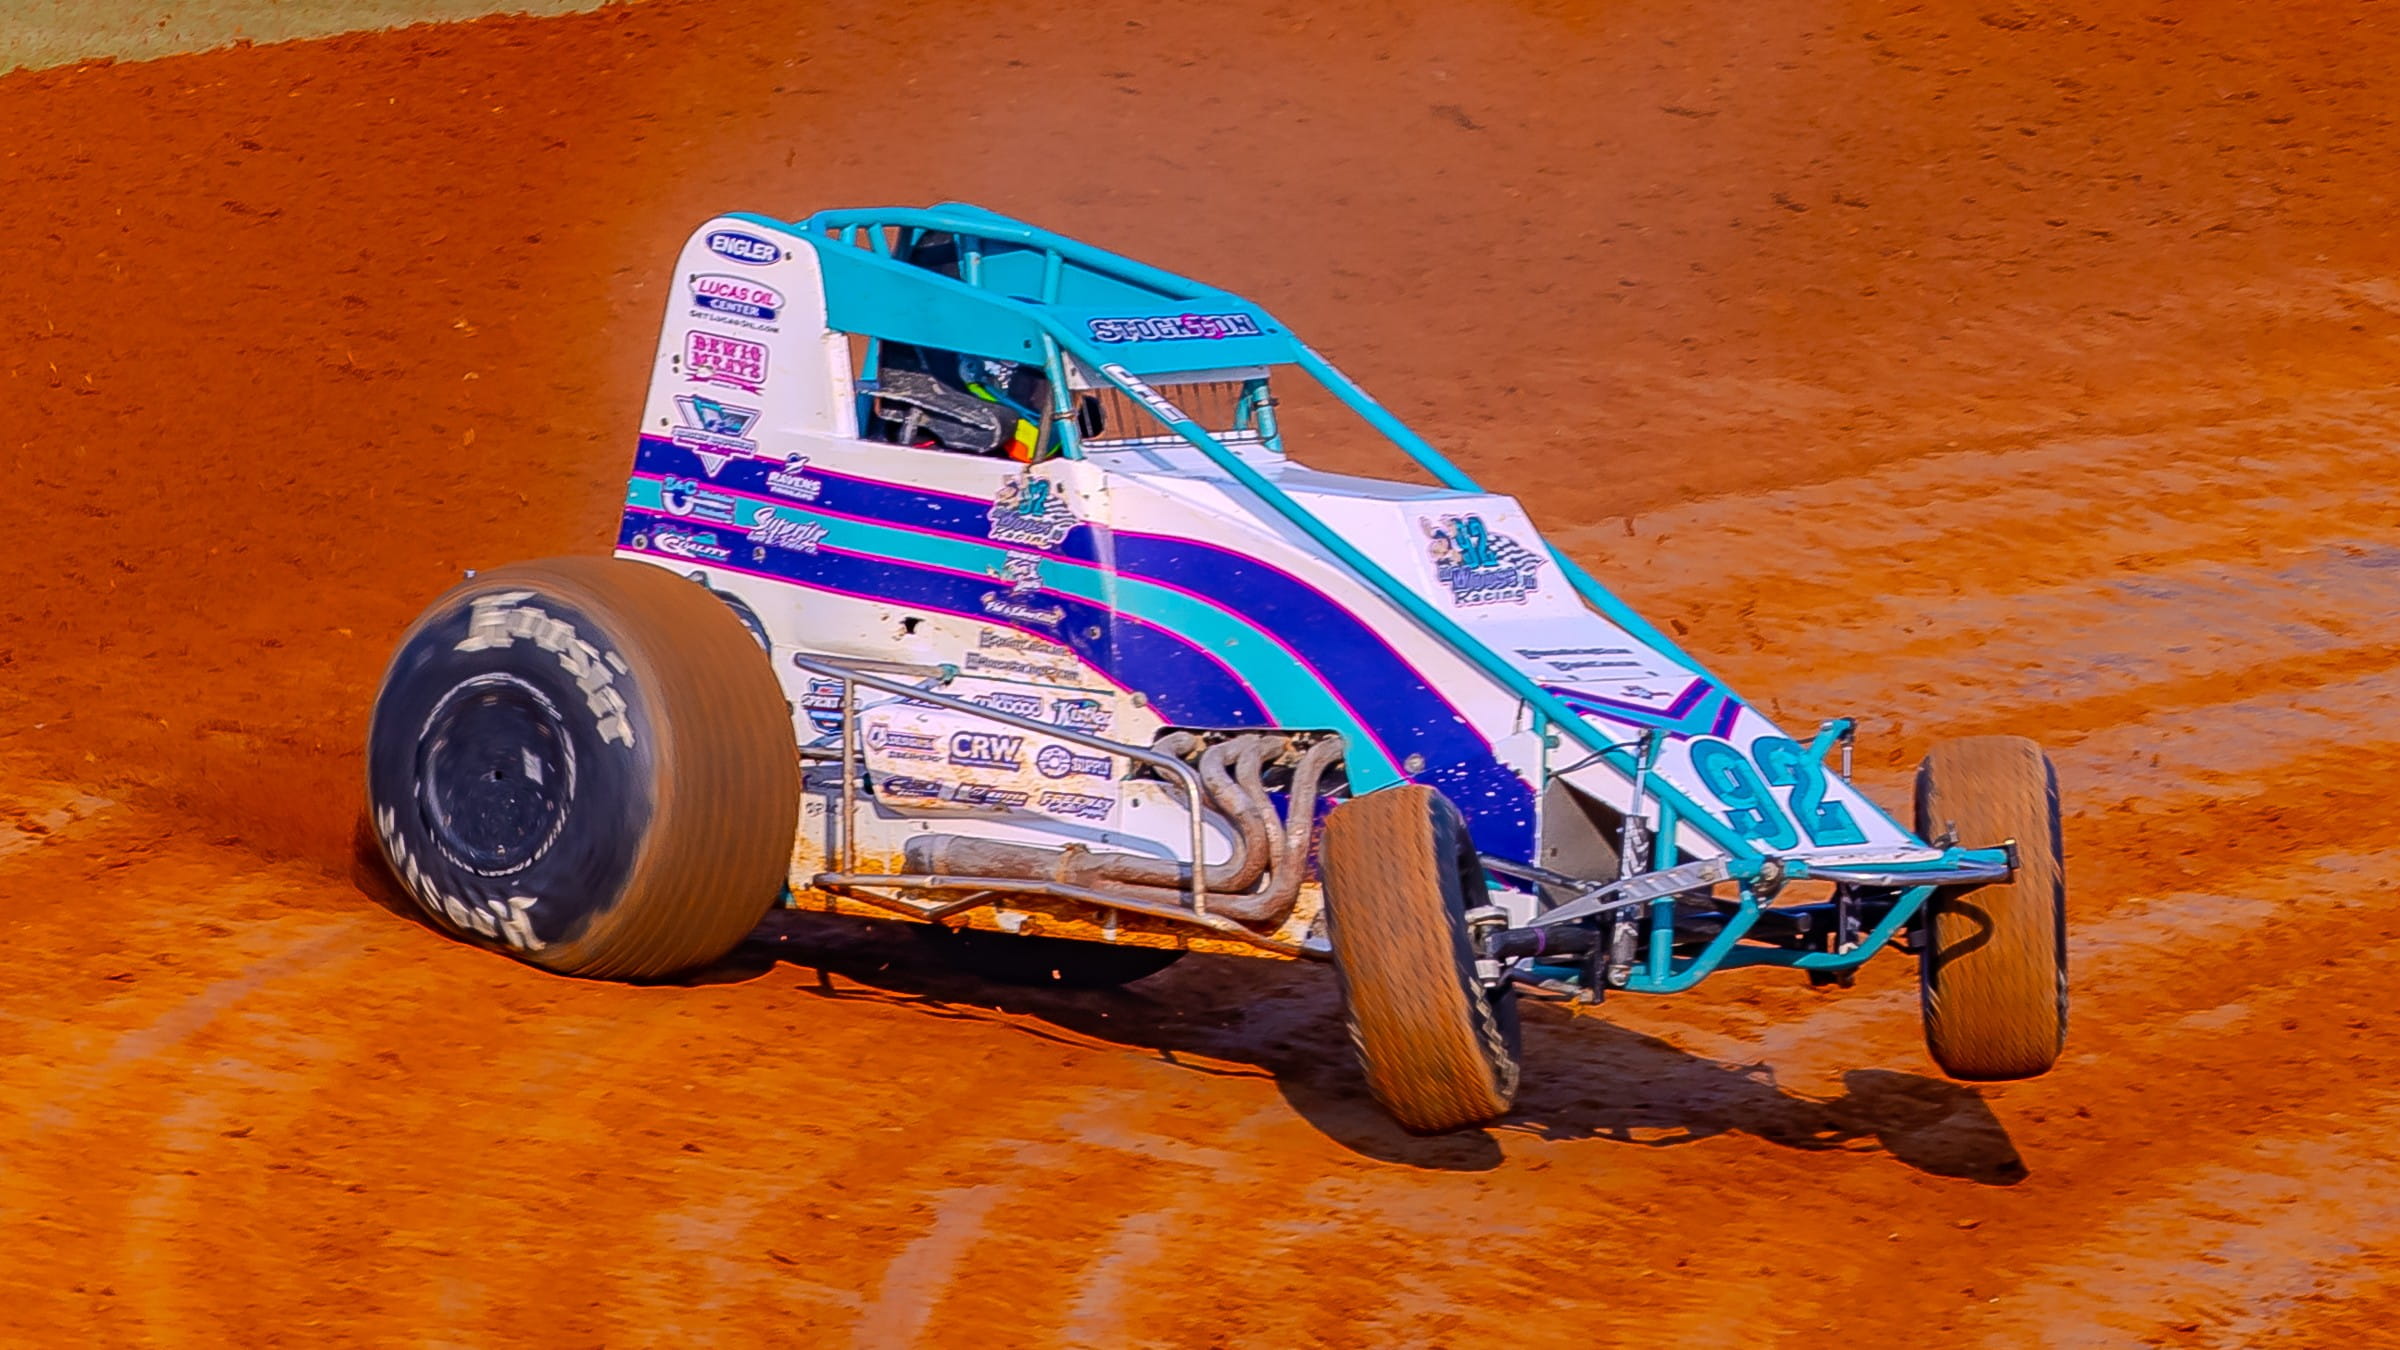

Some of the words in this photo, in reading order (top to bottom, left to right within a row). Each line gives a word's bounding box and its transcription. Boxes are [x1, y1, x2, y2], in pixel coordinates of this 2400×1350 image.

[712, 235, 775, 260] ENGLER
[698, 279, 750, 301] LUCAS
[751, 290, 776, 307] OIL
[710, 298, 760, 317] CENTER
[1454, 589, 1525, 605] Racing
[950, 732, 1023, 763] CRW
[1690, 735, 1868, 851] 92
